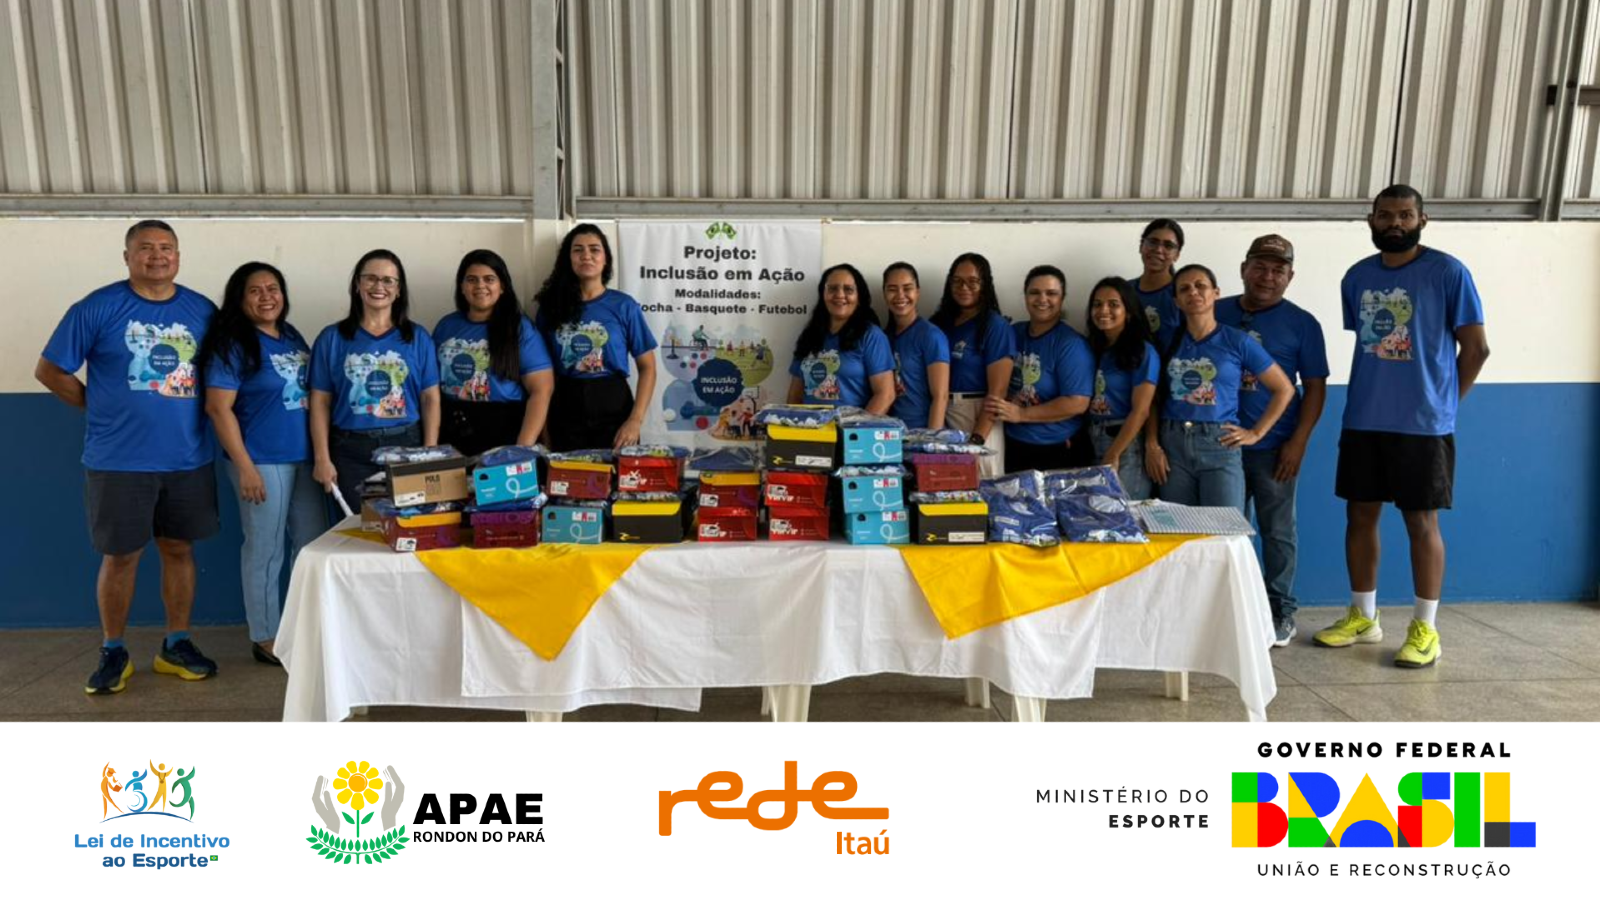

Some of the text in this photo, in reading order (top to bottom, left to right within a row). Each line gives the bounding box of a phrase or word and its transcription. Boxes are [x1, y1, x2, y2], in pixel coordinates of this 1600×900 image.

[684, 246, 757, 262] Projeto:
[640, 266, 805, 285] Inclusão em Ação
[675, 288, 761, 300] Modalidades:
[685, 304, 747, 315] Basquete
[758, 304, 807, 315] Futebol
[701, 375, 738, 385] INCLUSÃO
[702, 385, 736, 396] EM AÇÃO
